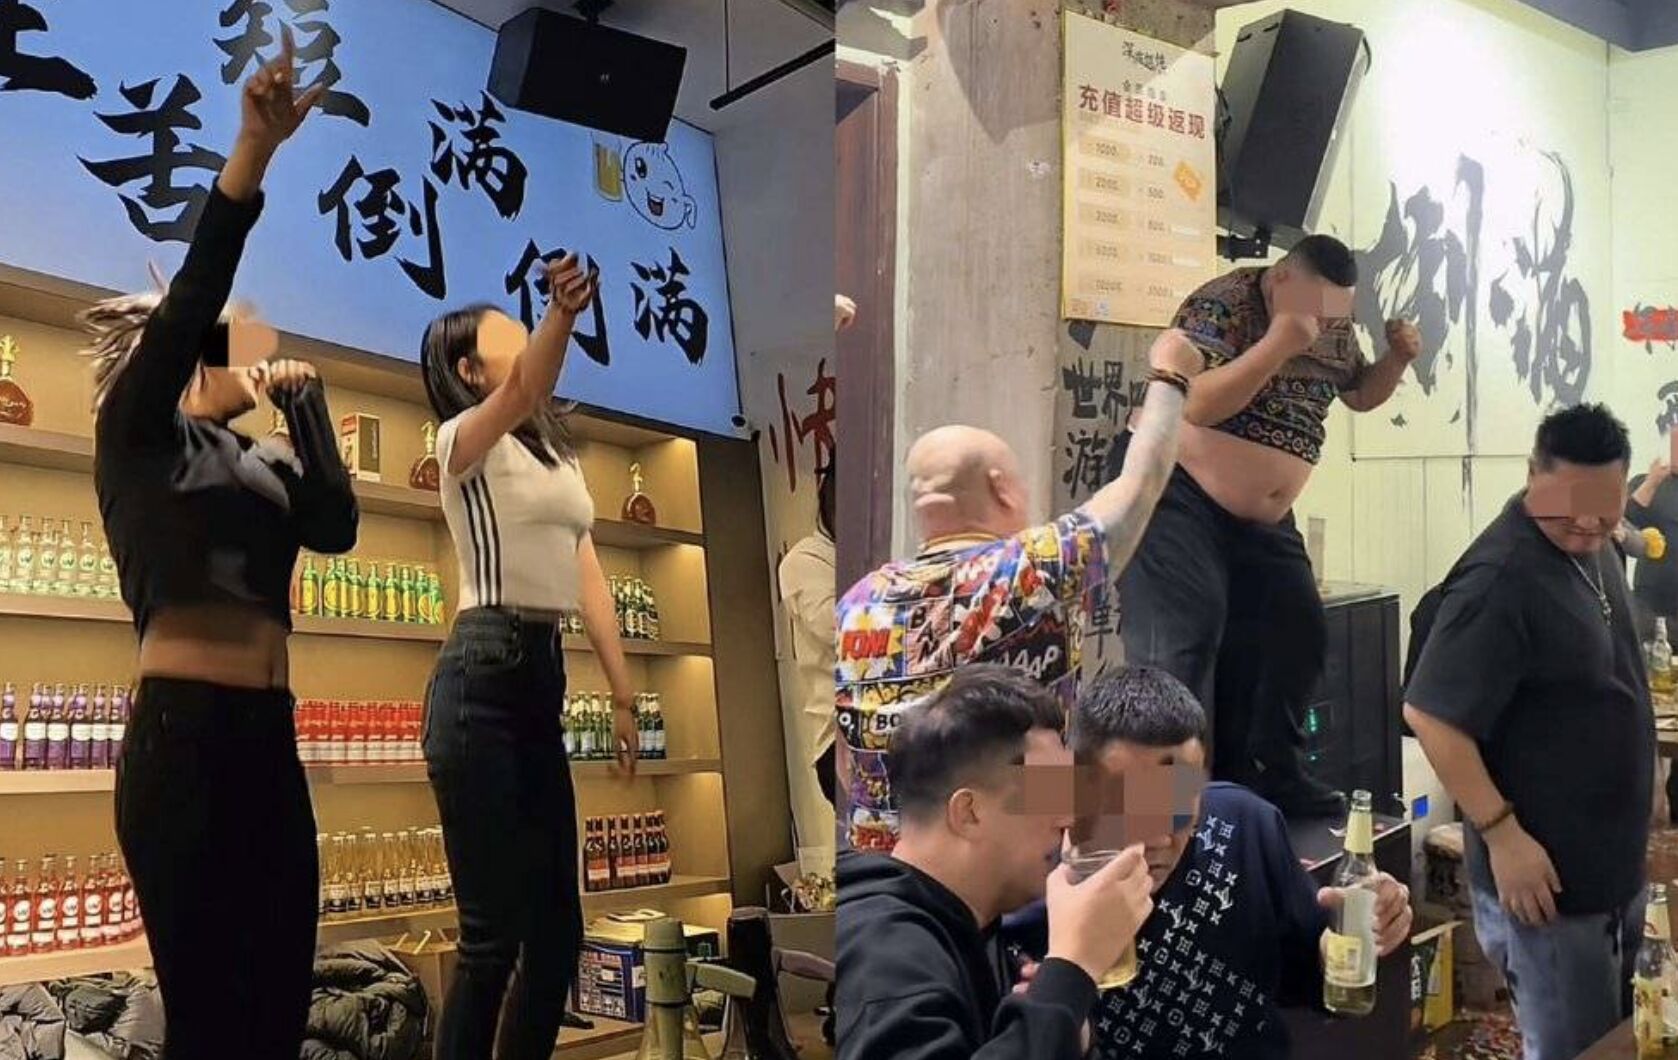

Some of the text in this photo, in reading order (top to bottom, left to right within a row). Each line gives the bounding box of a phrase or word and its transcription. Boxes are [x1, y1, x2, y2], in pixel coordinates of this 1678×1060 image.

[1078, 85, 1206, 140] 充值超级返现
